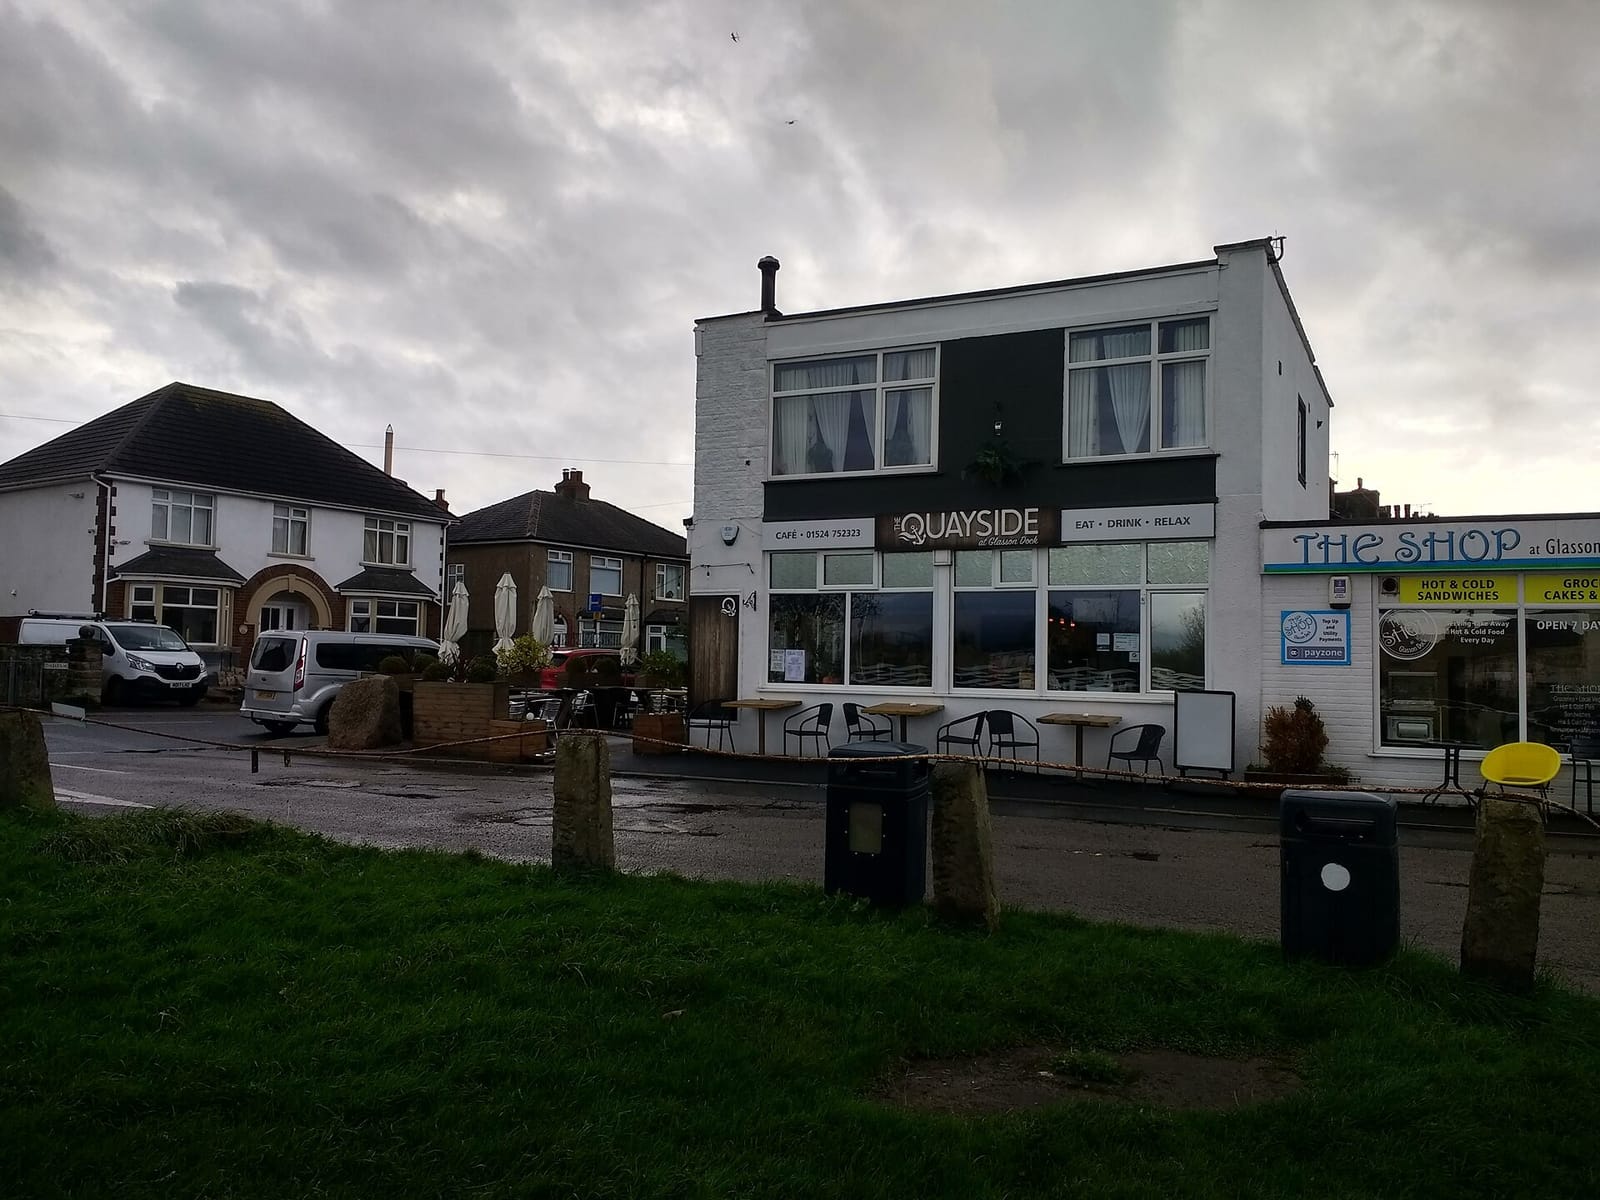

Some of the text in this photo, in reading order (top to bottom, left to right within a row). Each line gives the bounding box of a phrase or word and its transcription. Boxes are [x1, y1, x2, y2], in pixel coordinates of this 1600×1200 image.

[893, 508, 1039, 545] THE QUAYSIDE
[1075, 516, 1191, 529] EAT DRINK RELAX
[775, 528, 861, 540] CAFÉ 01524 752323
[978, 535, 1039, 546] at Glasson Dock
[1293, 528, 1600, 565] THE SHOP at Glasson
[1421, 579, 1495, 589] HOT & COLD
[1563, 578, 1600, 589] GROC
[1417, 591, 1499, 601] SANDWICHES
[1544, 590, 1597, 600] CAKES &
[1536, 620, 1568, 630] OPEN
[1572, 620, 1578, 630] 7
[1460, 637, 1495, 645] Every Day
[1304, 649, 1343, 658] payzone
